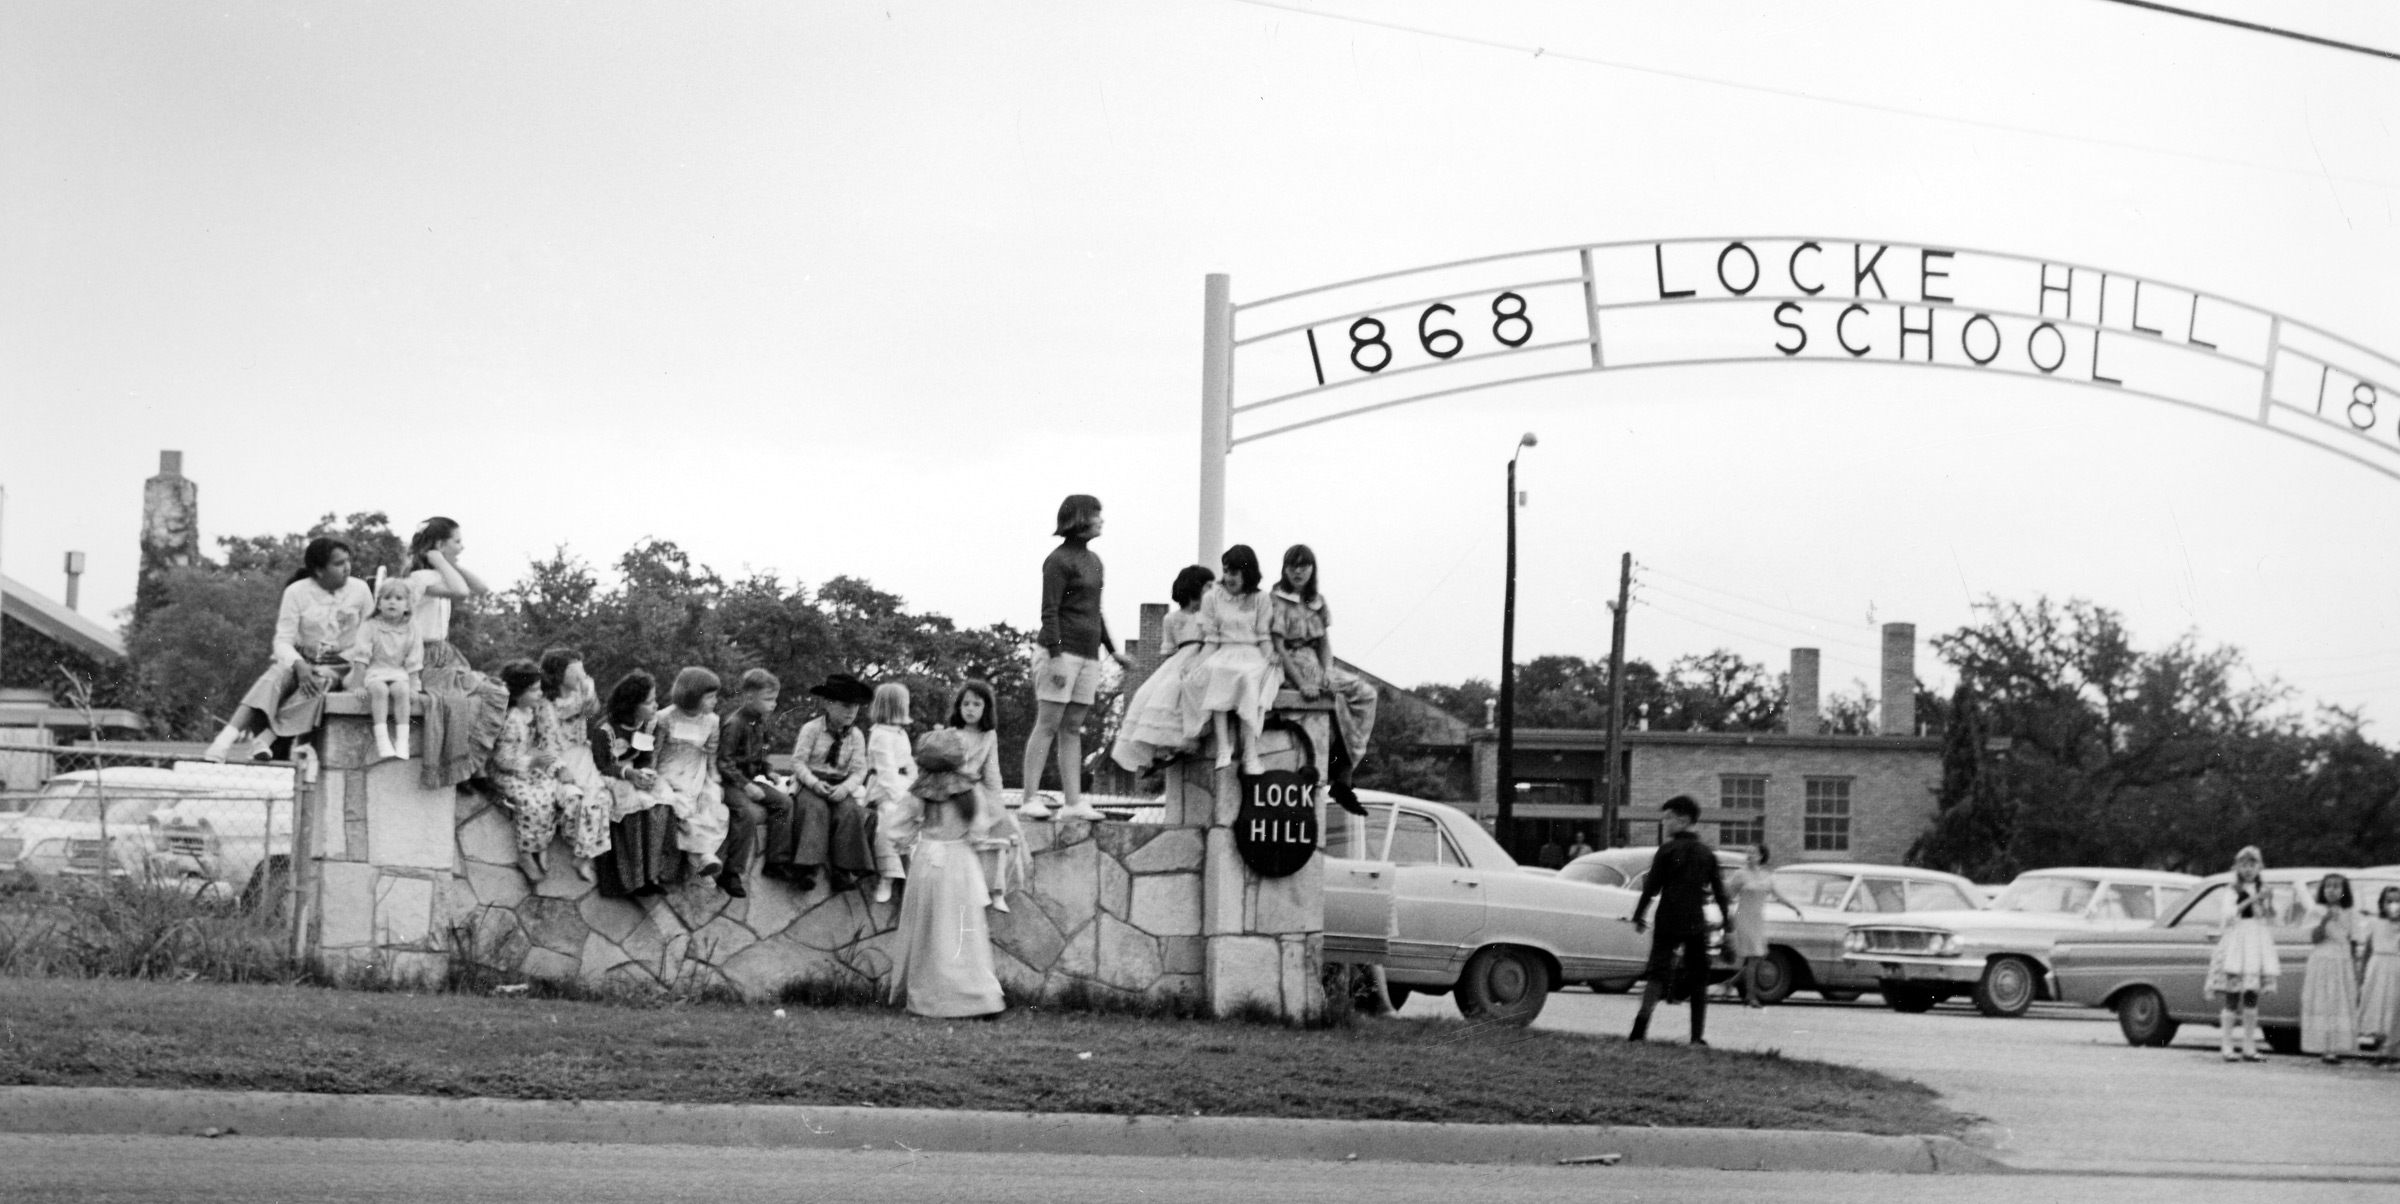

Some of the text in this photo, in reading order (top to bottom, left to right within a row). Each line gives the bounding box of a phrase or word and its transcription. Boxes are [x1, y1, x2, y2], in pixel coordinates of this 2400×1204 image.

[1655, 242, 2218, 350] LOCKE HILL
[1306, 291, 1534, 386] 1868
[1773, 301, 2123, 386] SCHOOL
[2316, 365, 2400, 432] 18
[1249, 818, 1312, 844] HILL
[1253, 783, 1315, 808] LOCK
